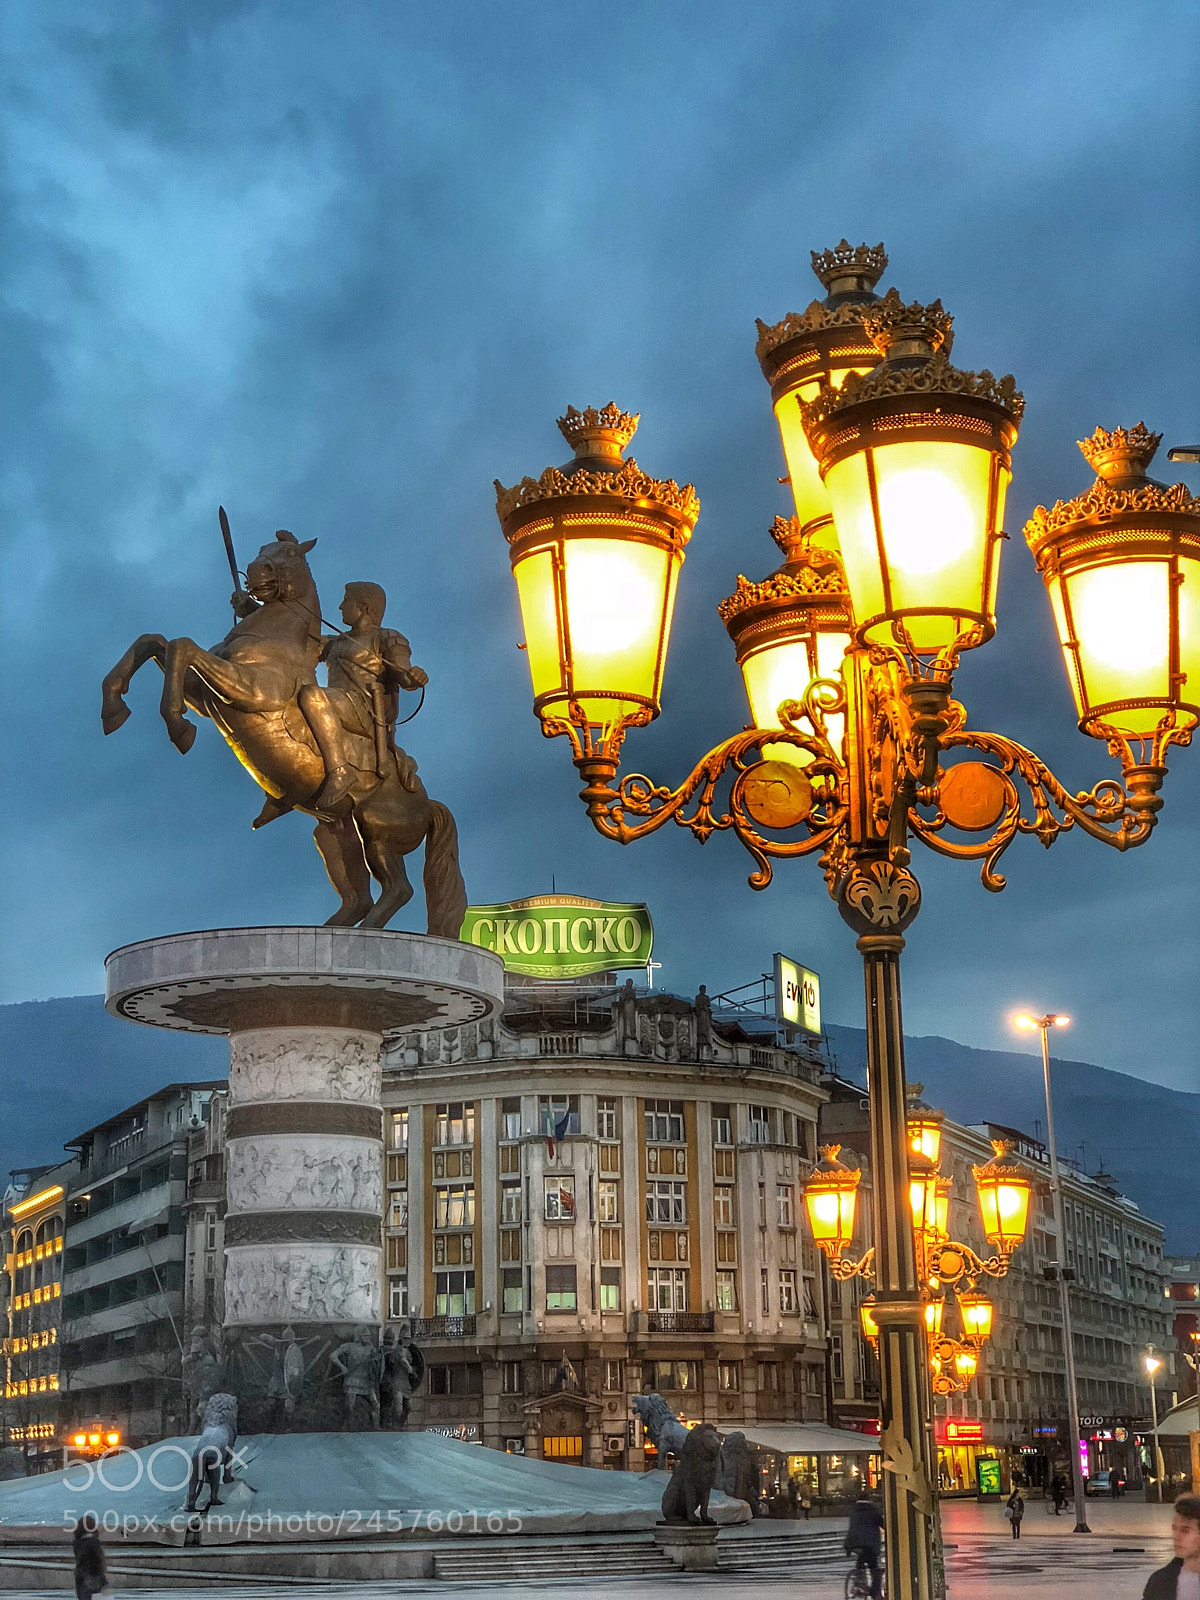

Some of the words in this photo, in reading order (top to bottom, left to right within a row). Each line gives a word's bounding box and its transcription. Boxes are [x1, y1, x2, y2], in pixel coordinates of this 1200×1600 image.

[517, 898, 557, 908] PREMIUM
[559, 898, 595, 907] QUALITY
[471, 916, 642, 955] СКОПСКО
[786, 980, 803, 1005] EVN
[1079, 1416, 1104, 1426] TOTO
